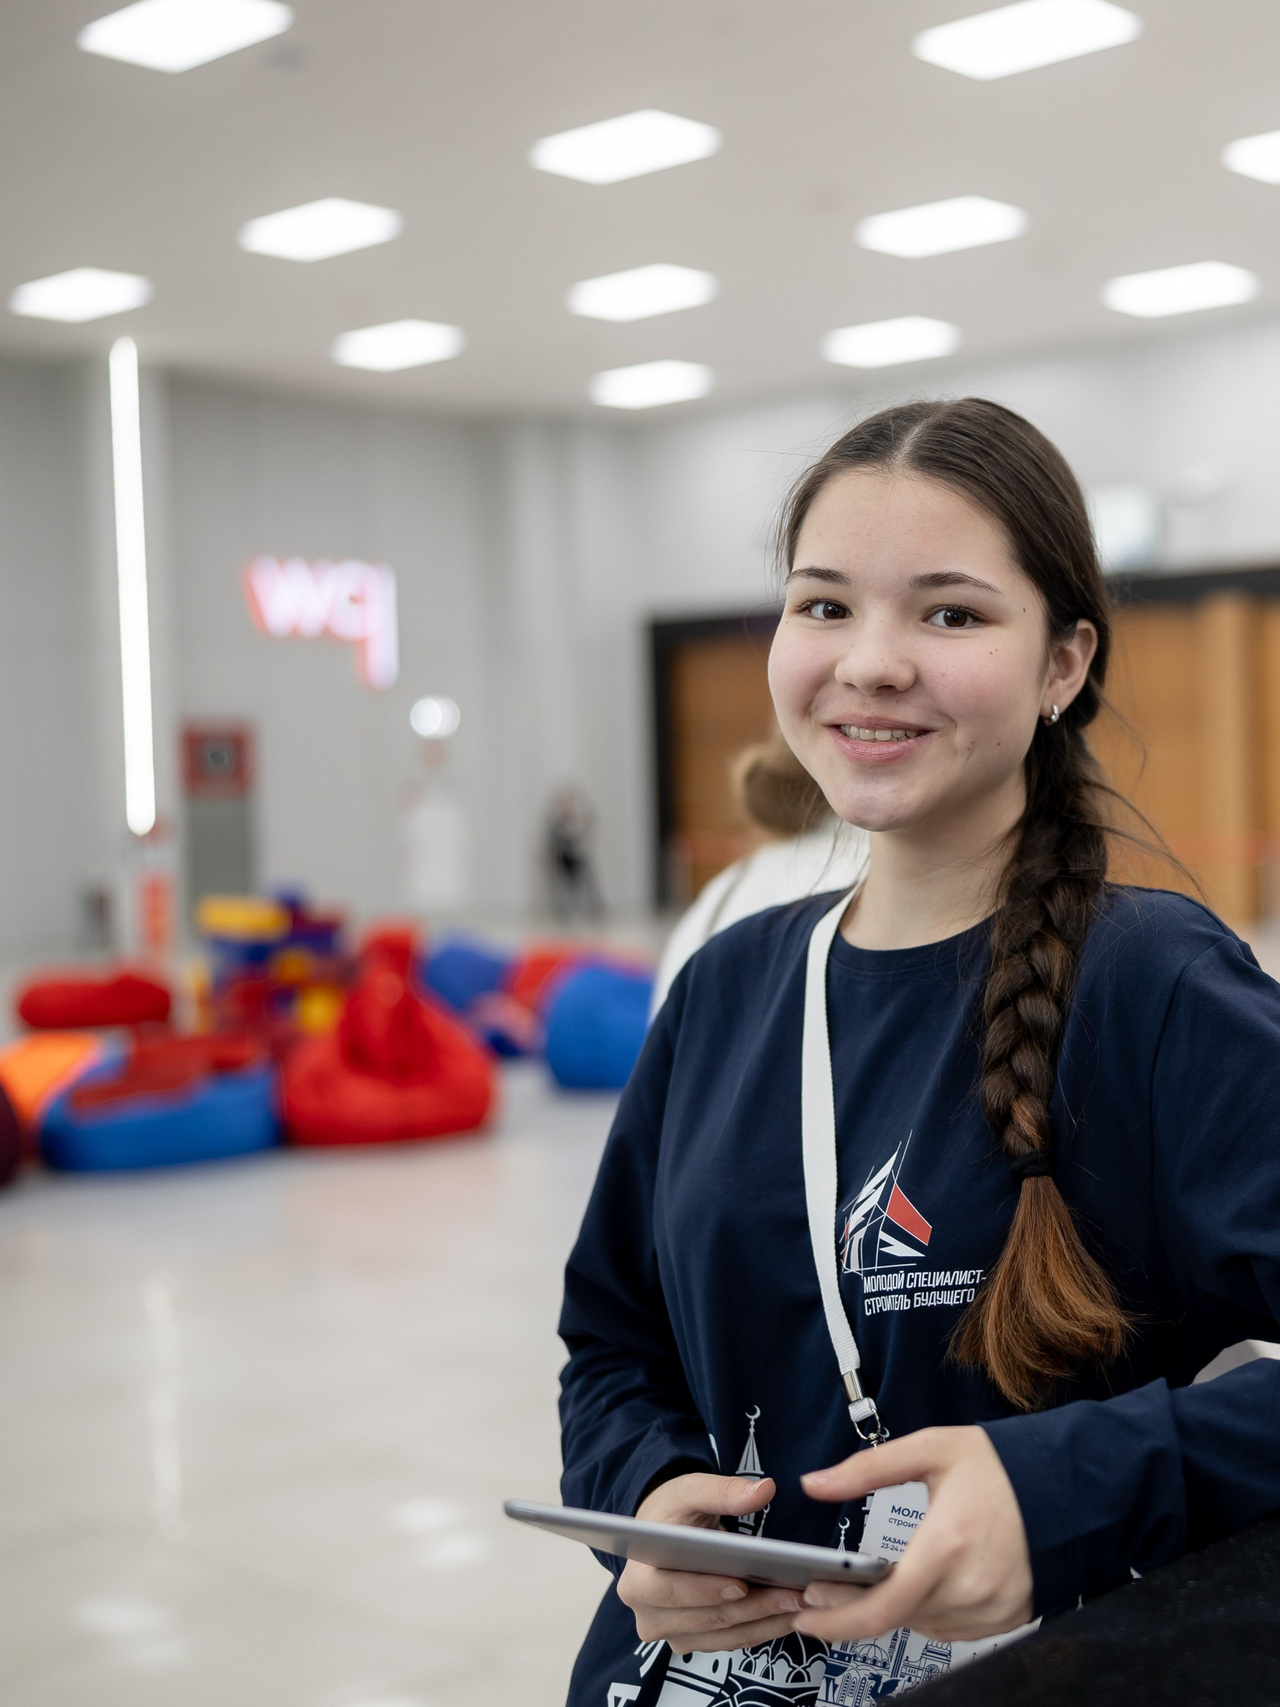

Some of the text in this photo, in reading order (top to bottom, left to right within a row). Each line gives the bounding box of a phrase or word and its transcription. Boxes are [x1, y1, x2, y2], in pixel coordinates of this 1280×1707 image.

[863, 1270, 904, 1293] МОЛОДОЙ
[864, 1288, 975, 1316] СТРОИТЕЛЬ БУДУЩЕГО
[881, 1542, 899, 1552] 23-24
